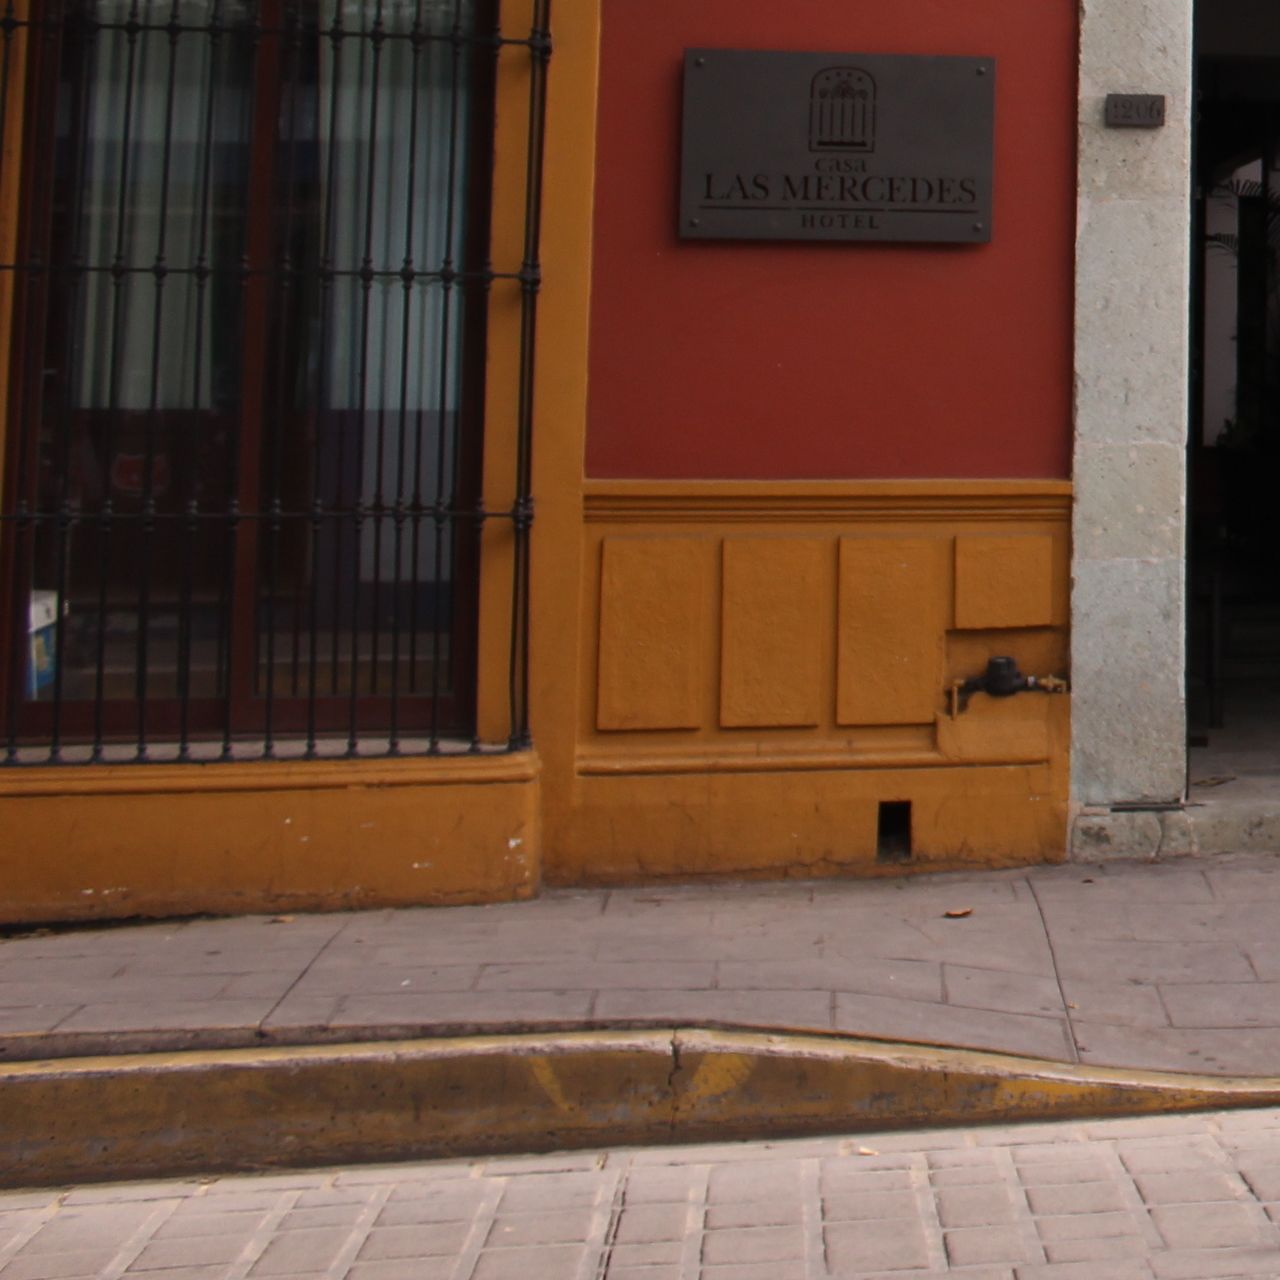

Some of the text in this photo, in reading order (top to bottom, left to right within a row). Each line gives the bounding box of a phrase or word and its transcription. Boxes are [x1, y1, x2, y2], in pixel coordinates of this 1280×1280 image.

[814, 156, 867, 173] casa
[703, 172, 977, 204] LAS MERCEDES
[800, 213, 880, 230] HOTEL
